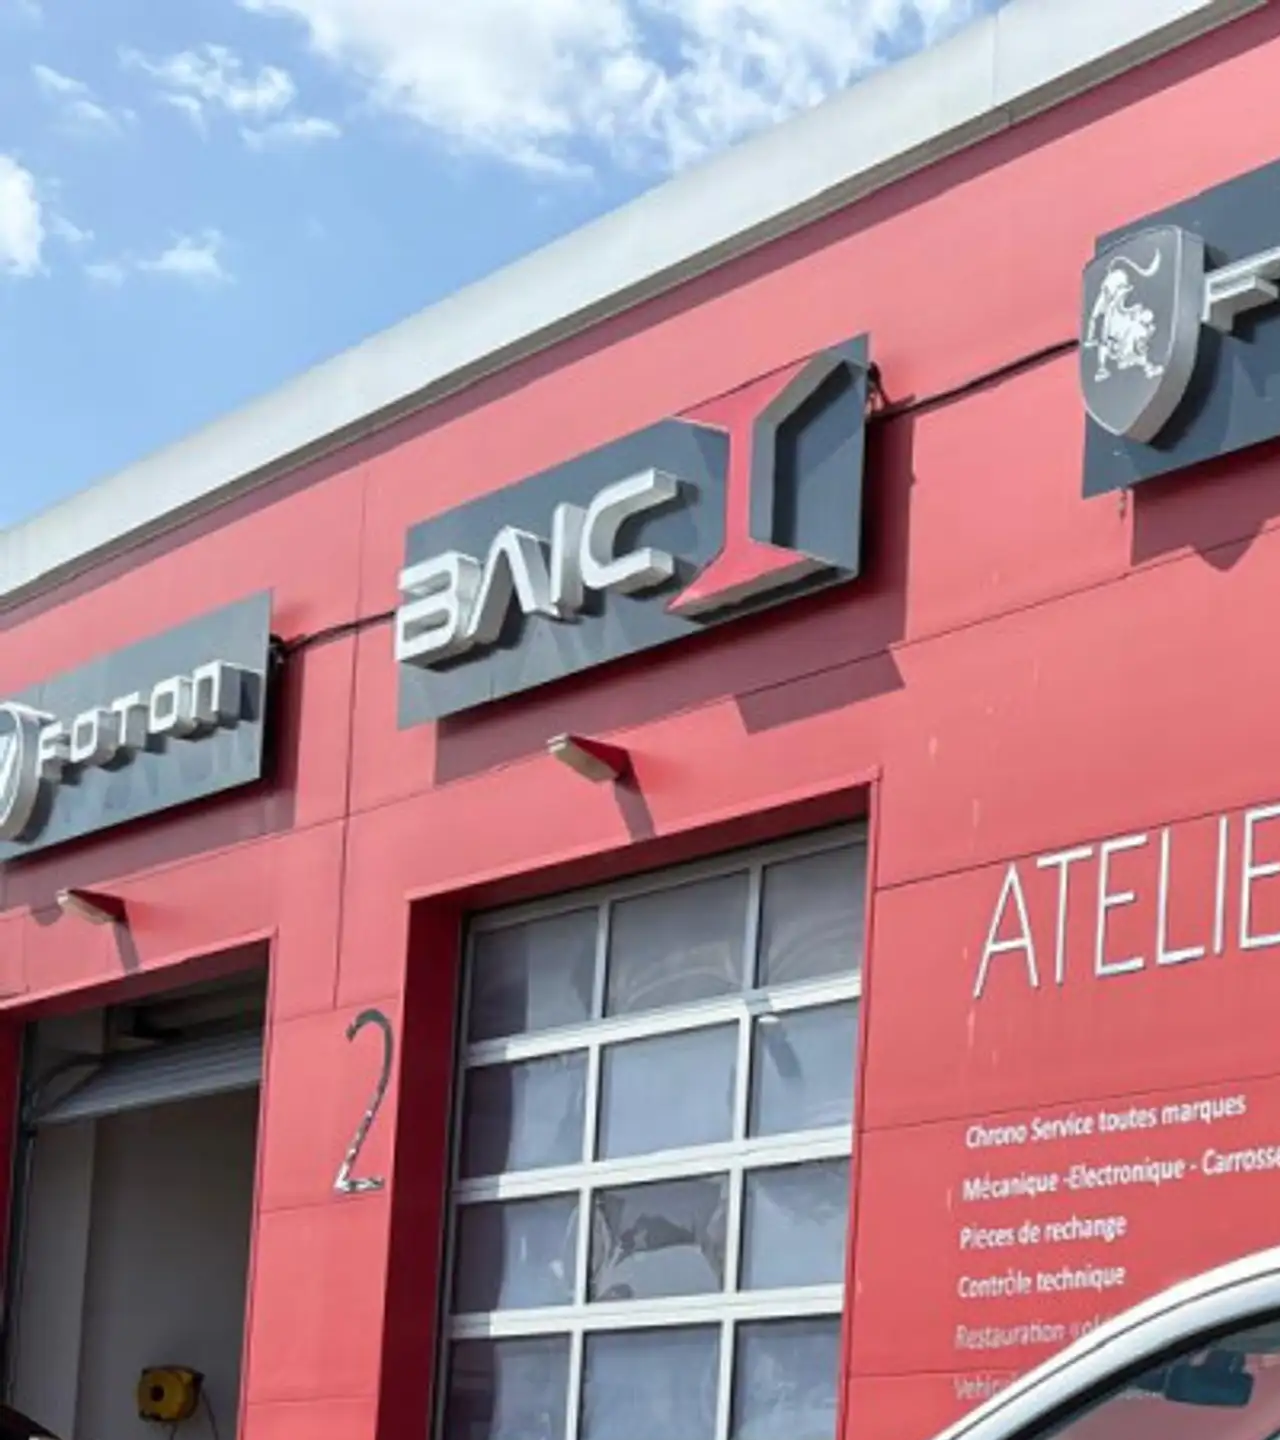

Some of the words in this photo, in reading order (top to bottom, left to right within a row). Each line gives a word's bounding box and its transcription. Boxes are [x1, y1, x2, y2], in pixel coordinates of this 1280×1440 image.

[395, 467, 676, 663] BAIC
[35, 659, 240, 778] FOTON
[334, 1008, 393, 1194] 2
[966, 1124, 1027, 1148] Chrono
[1031, 1112, 1094, 1141] Service
[1098, 1107, 1157, 1131] toutes
[1161, 1094, 1246, 1124] marques
[962, 1171, 1059, 1200] Mécanique
[1017, 1219, 1040, 1244] de
[1044, 1213, 1127, 1242] rechange
[1036, 1264, 1126, 1292] technique
[955, 1318, 1065, 1350] Restauration
